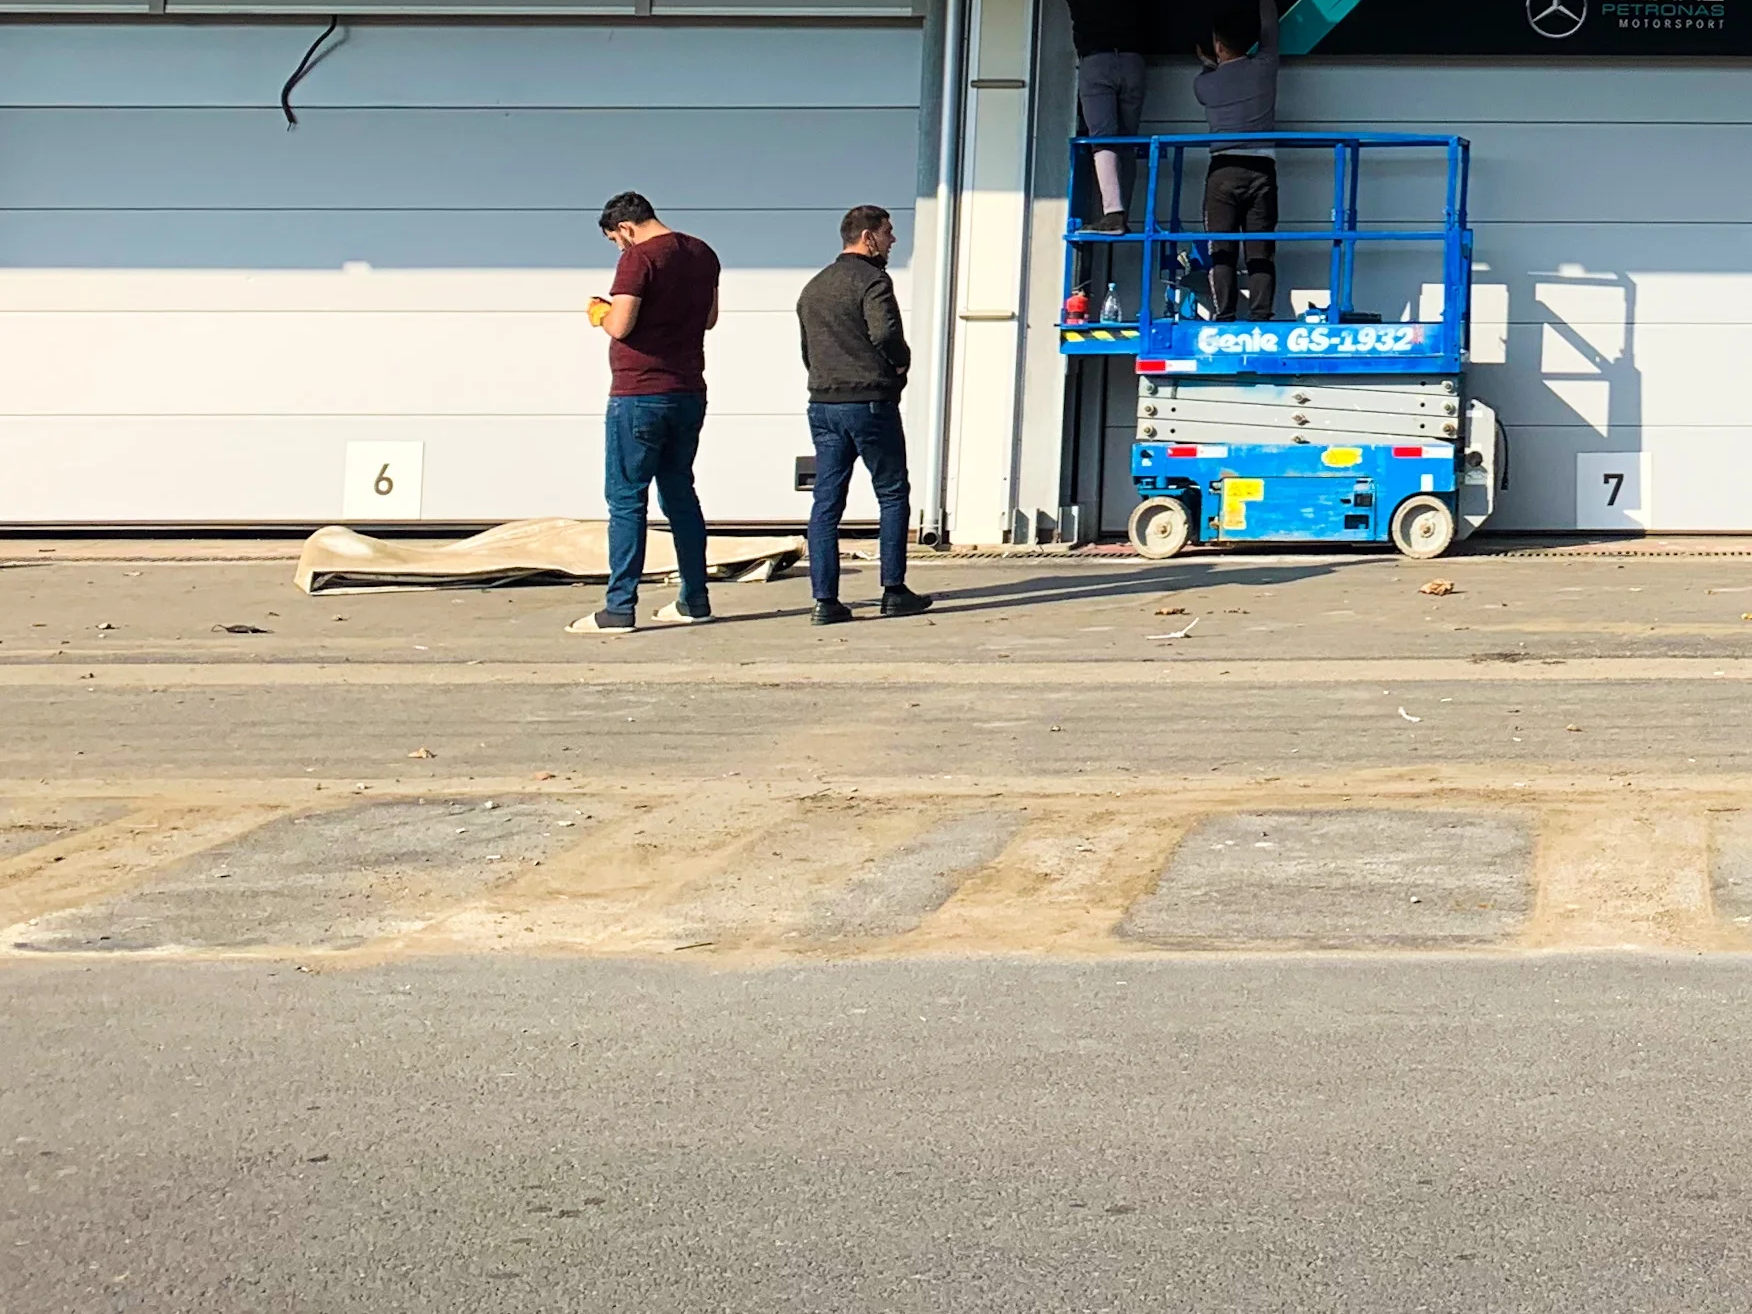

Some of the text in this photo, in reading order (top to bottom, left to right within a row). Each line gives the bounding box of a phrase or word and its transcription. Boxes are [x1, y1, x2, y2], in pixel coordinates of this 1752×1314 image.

[1601, 4, 1725, 16] PETRONAS
[1618, 19, 1725, 29] MOTORSPORT
[1198, 326, 1413, 353] Genie GS-1932
[374, 463, 394, 496] 6
[1603, 473, 1624, 506] 7
